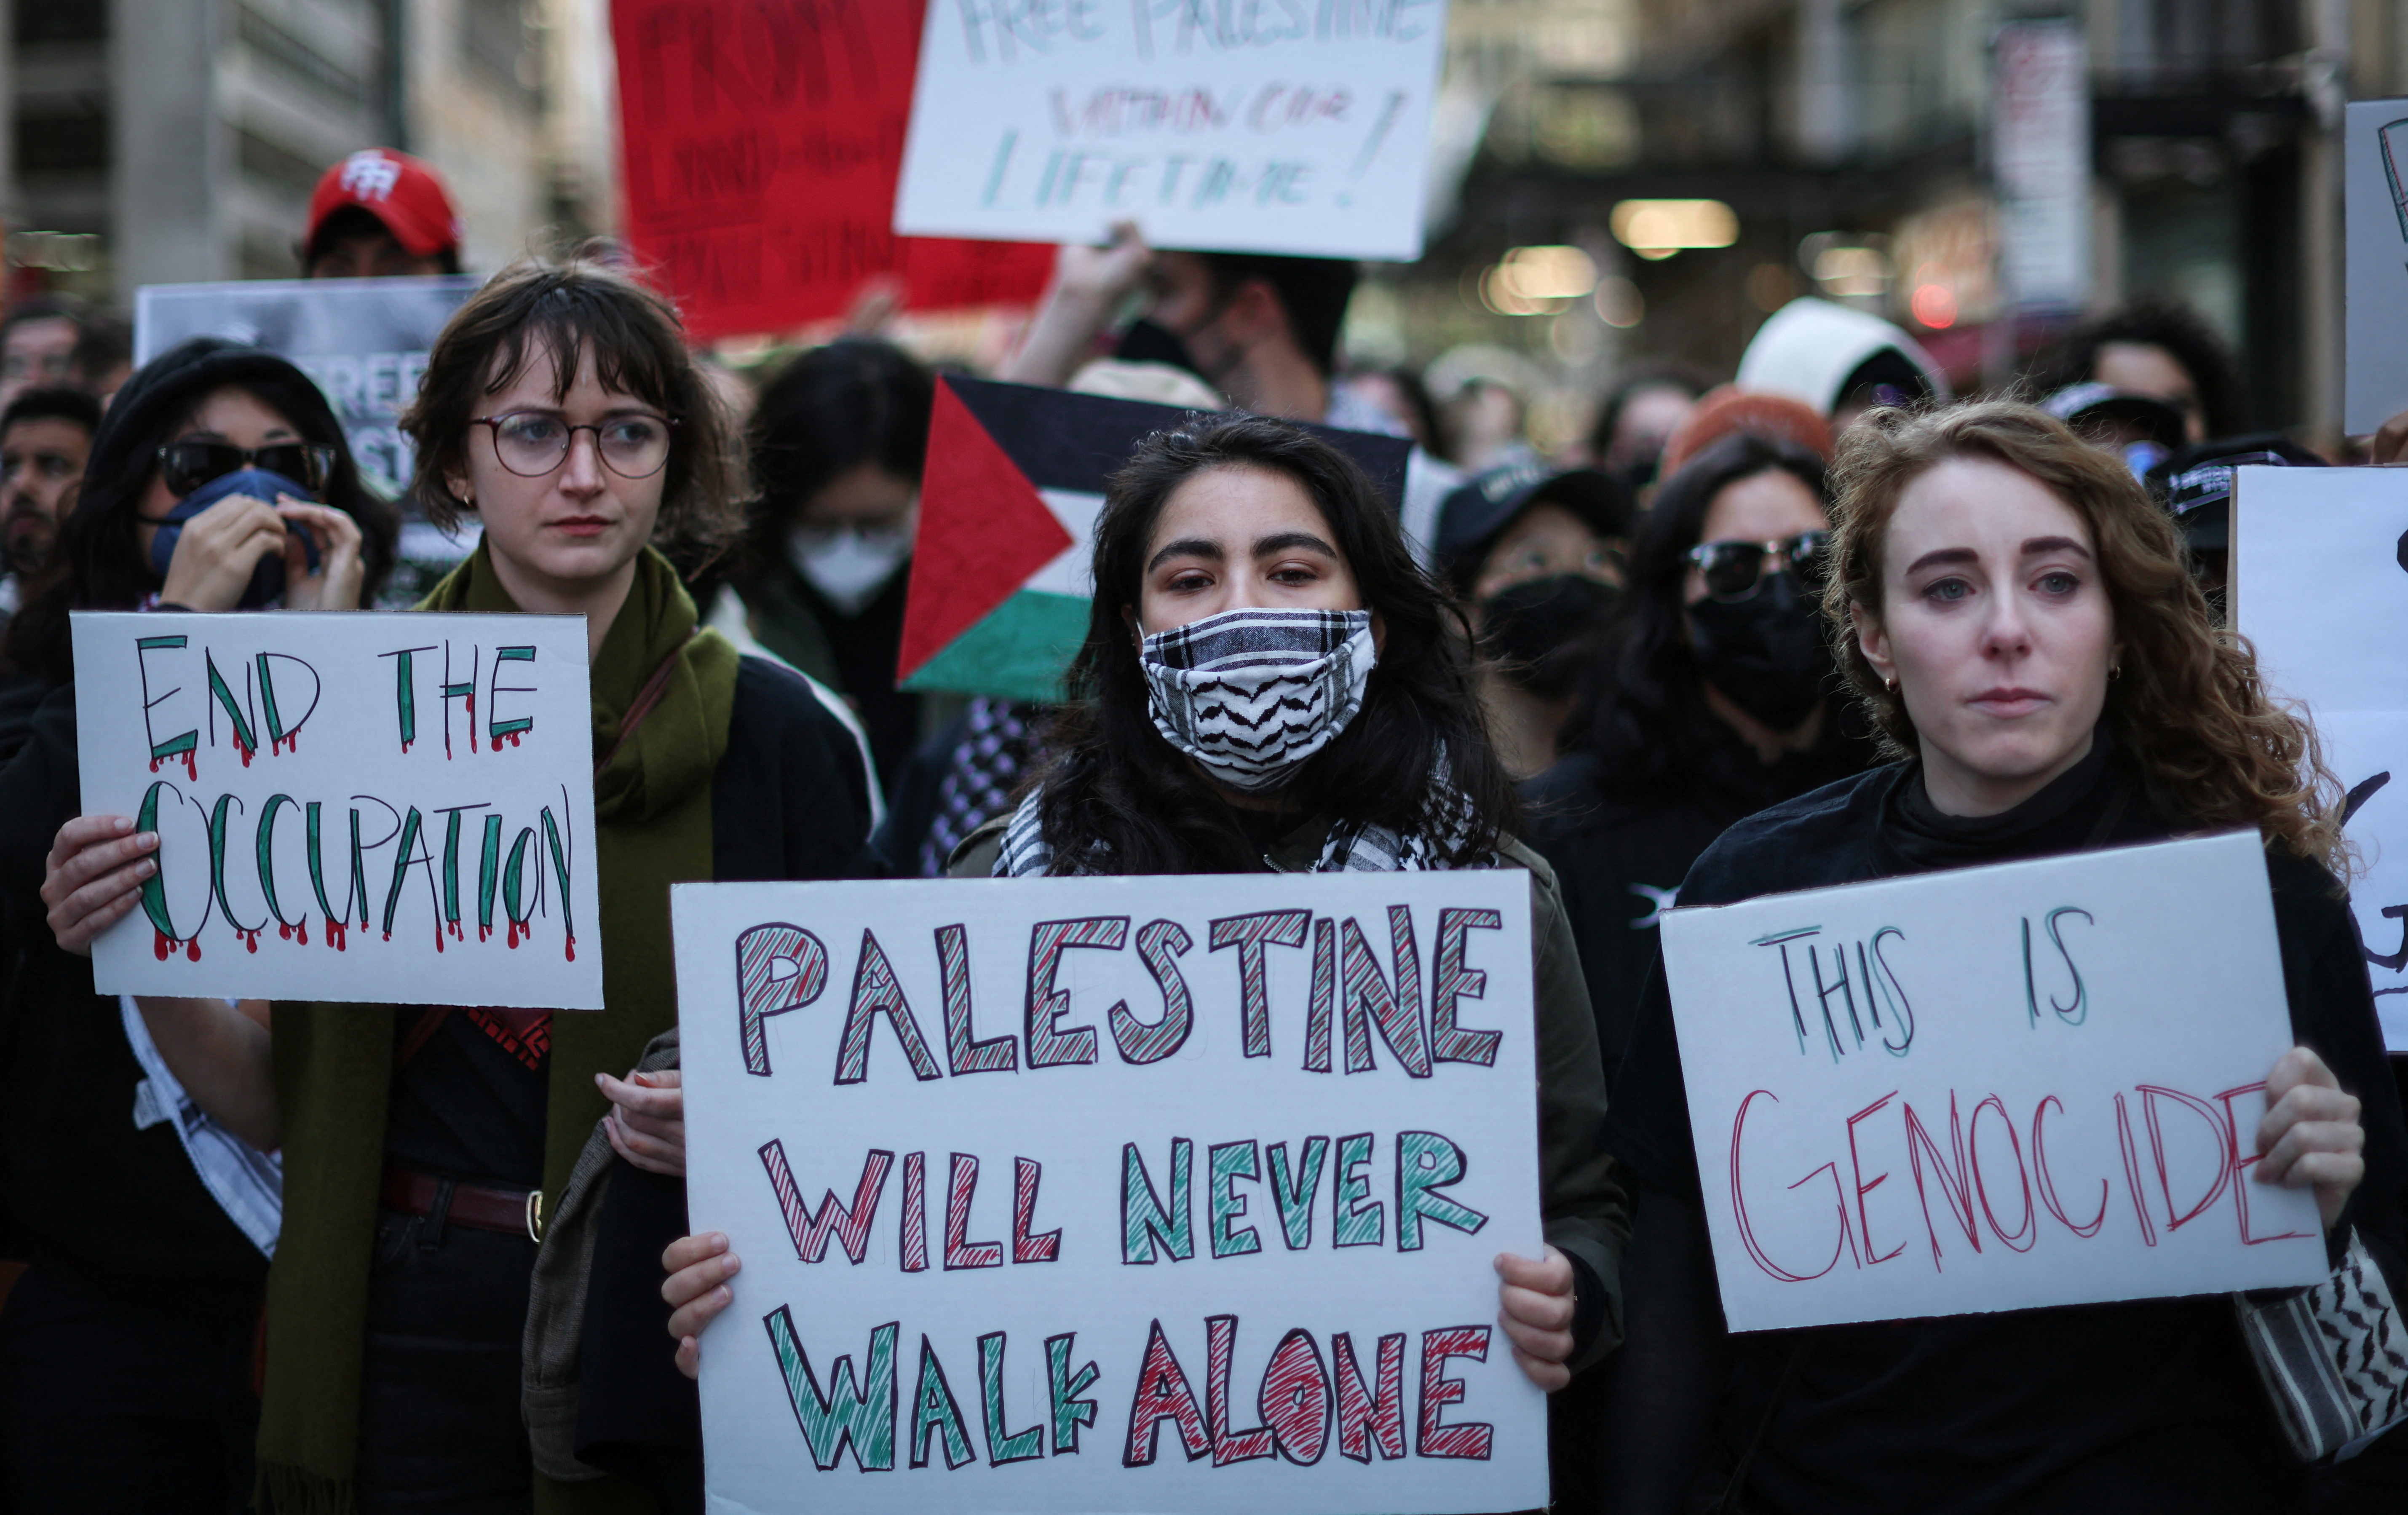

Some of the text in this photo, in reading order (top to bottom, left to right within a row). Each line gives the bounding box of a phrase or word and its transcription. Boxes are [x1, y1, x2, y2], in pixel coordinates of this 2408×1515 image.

[135, 635, 538, 760] END THE
[136, 781, 576, 944] OCCUPATION
[736, 904, 1503, 1084] PALESTINE
[1748, 906, 2094, 1063] THIS IS
[757, 1130, 1489, 1272] WILL NEVER
[1730, 1080, 2316, 1283] GENOCIDE
[763, 1304, 1494, 1472] WALK ALONE
